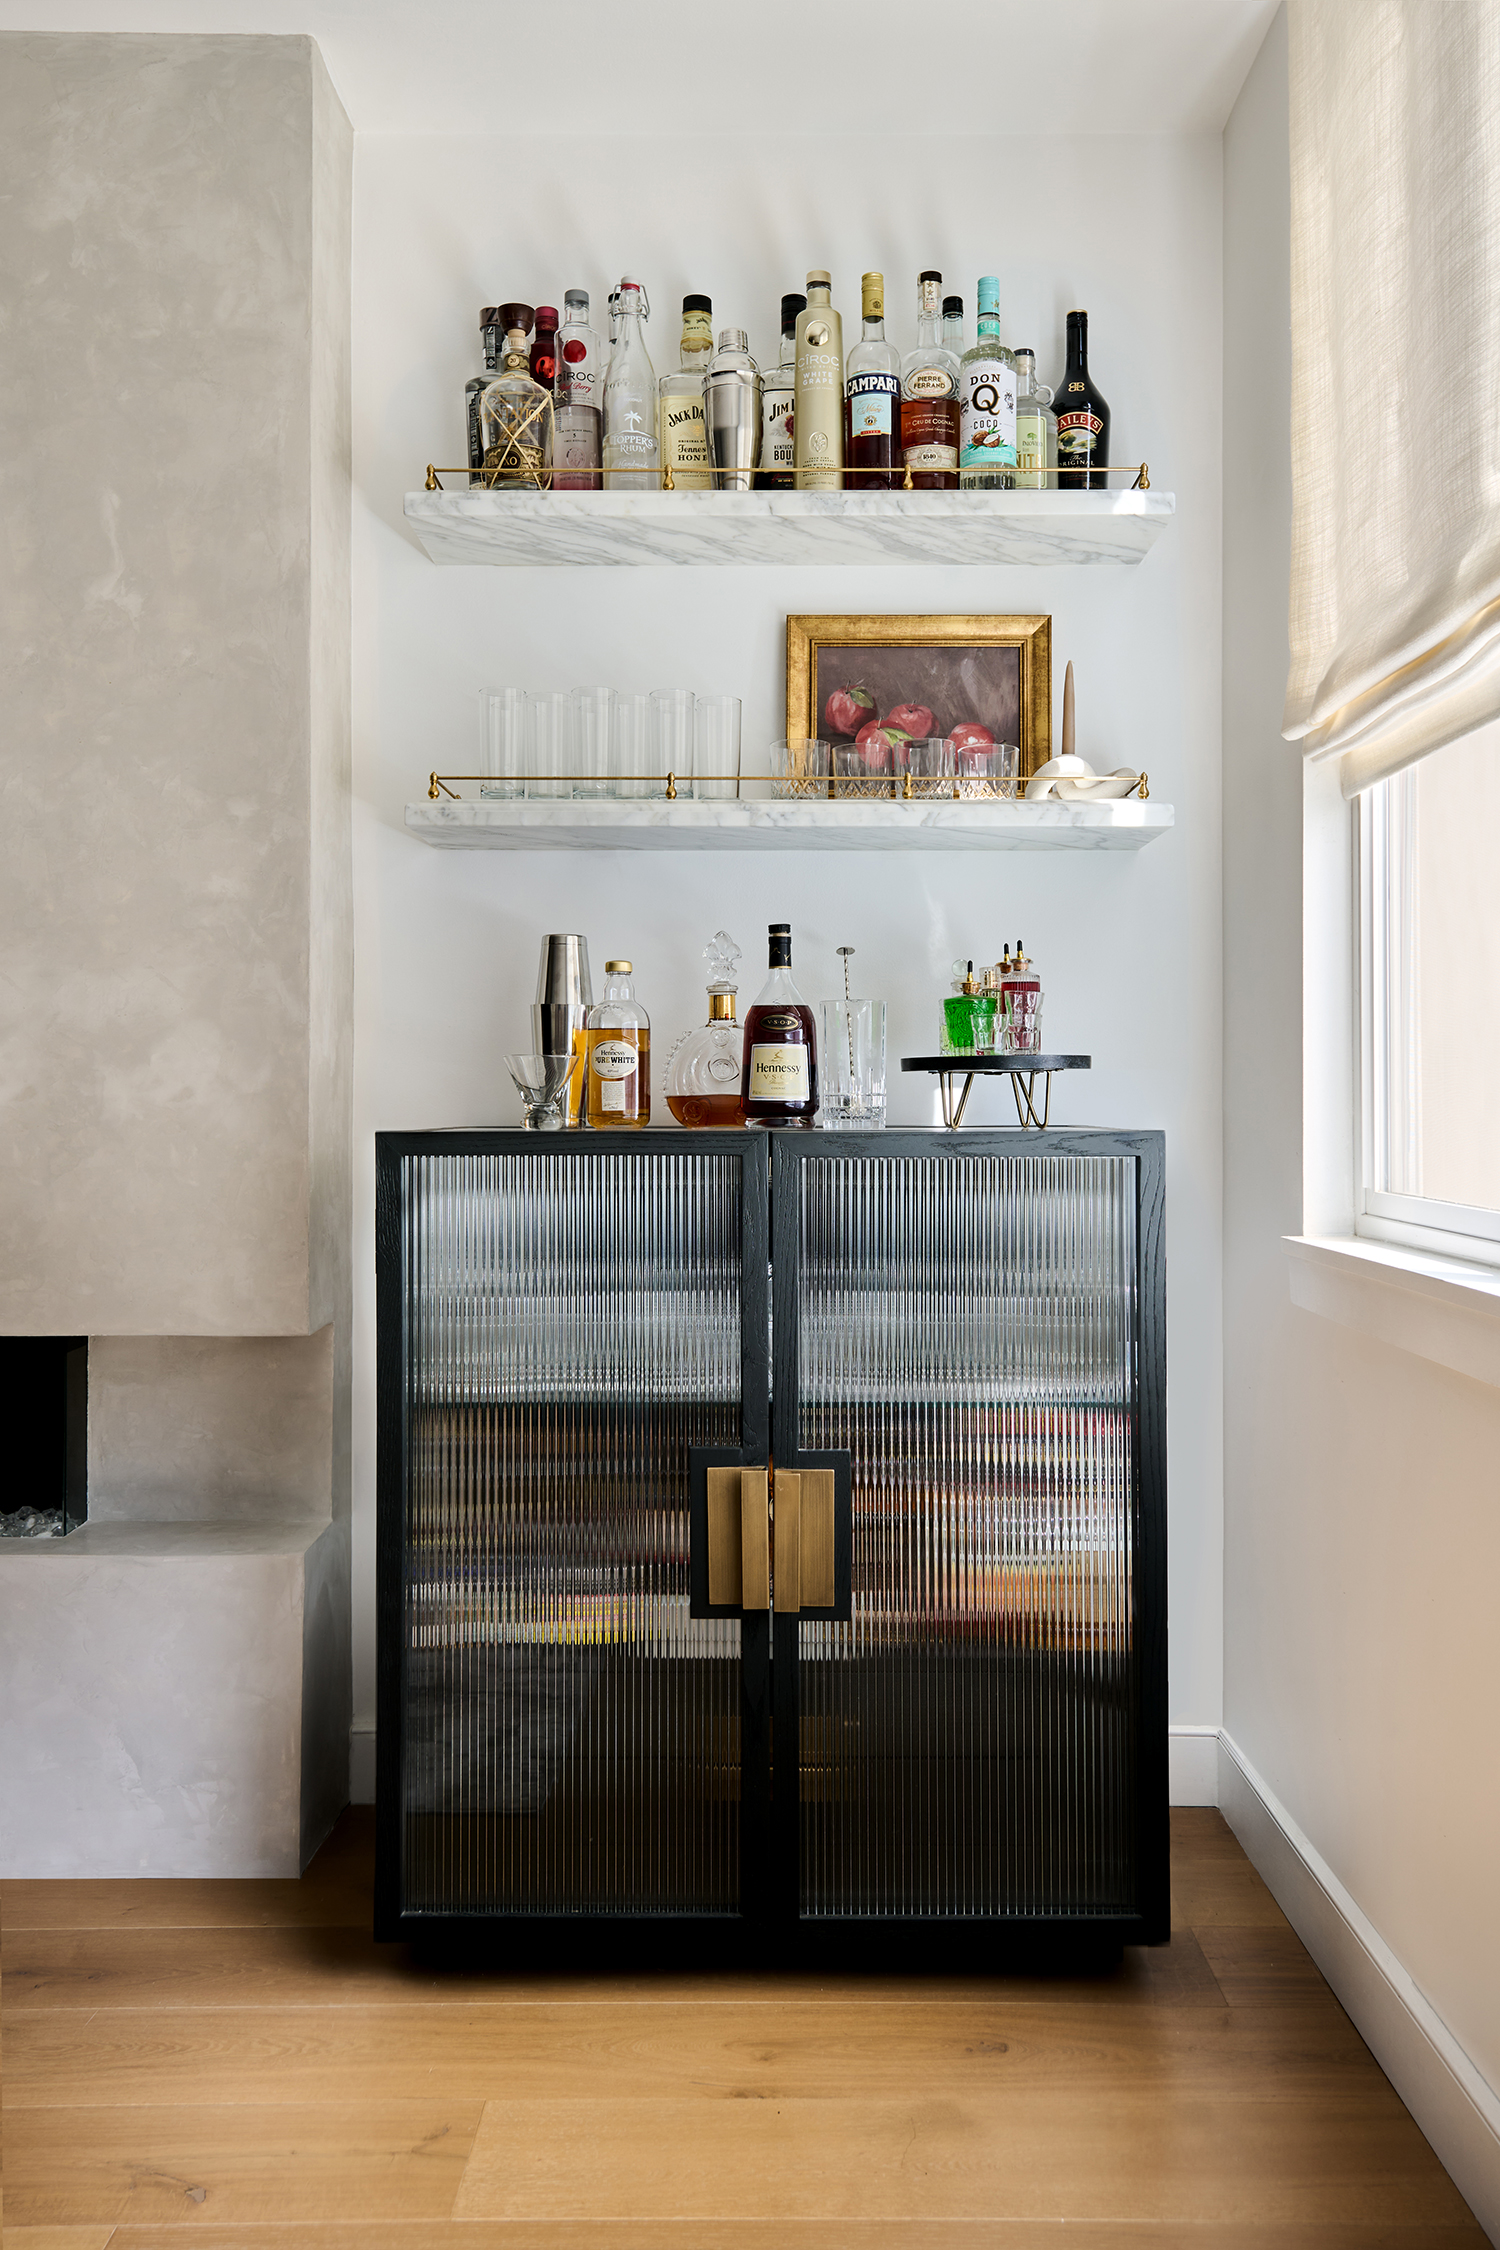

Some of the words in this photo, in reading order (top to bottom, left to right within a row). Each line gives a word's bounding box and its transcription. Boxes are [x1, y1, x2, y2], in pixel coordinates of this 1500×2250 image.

[802, 377, 834, 386] GRAPE
[803, 371, 833, 379] WHITE
[970, 373, 1001, 387] DON
[572, 381, 592, 394] Berry
[846, 375, 898, 397] CAMPARI
[913, 382, 946, 390] FERRAND
[970, 383, 1001, 417] Q
[667, 408, 691, 428] JACK
[769, 402, 790, 422] JIM
[932, 418, 955, 427] COGNAC
[973, 419, 999, 430] COCO
[1058, 414, 1101, 429] AILEYS
[612, 434, 654, 450] TOPPER'S
[620, 444, 646, 456] RHUM
[600, 1049, 627, 1057] Hennessy
[610, 1056, 636, 1064] WHITE
[756, 1063, 802, 1076] Hennessy
